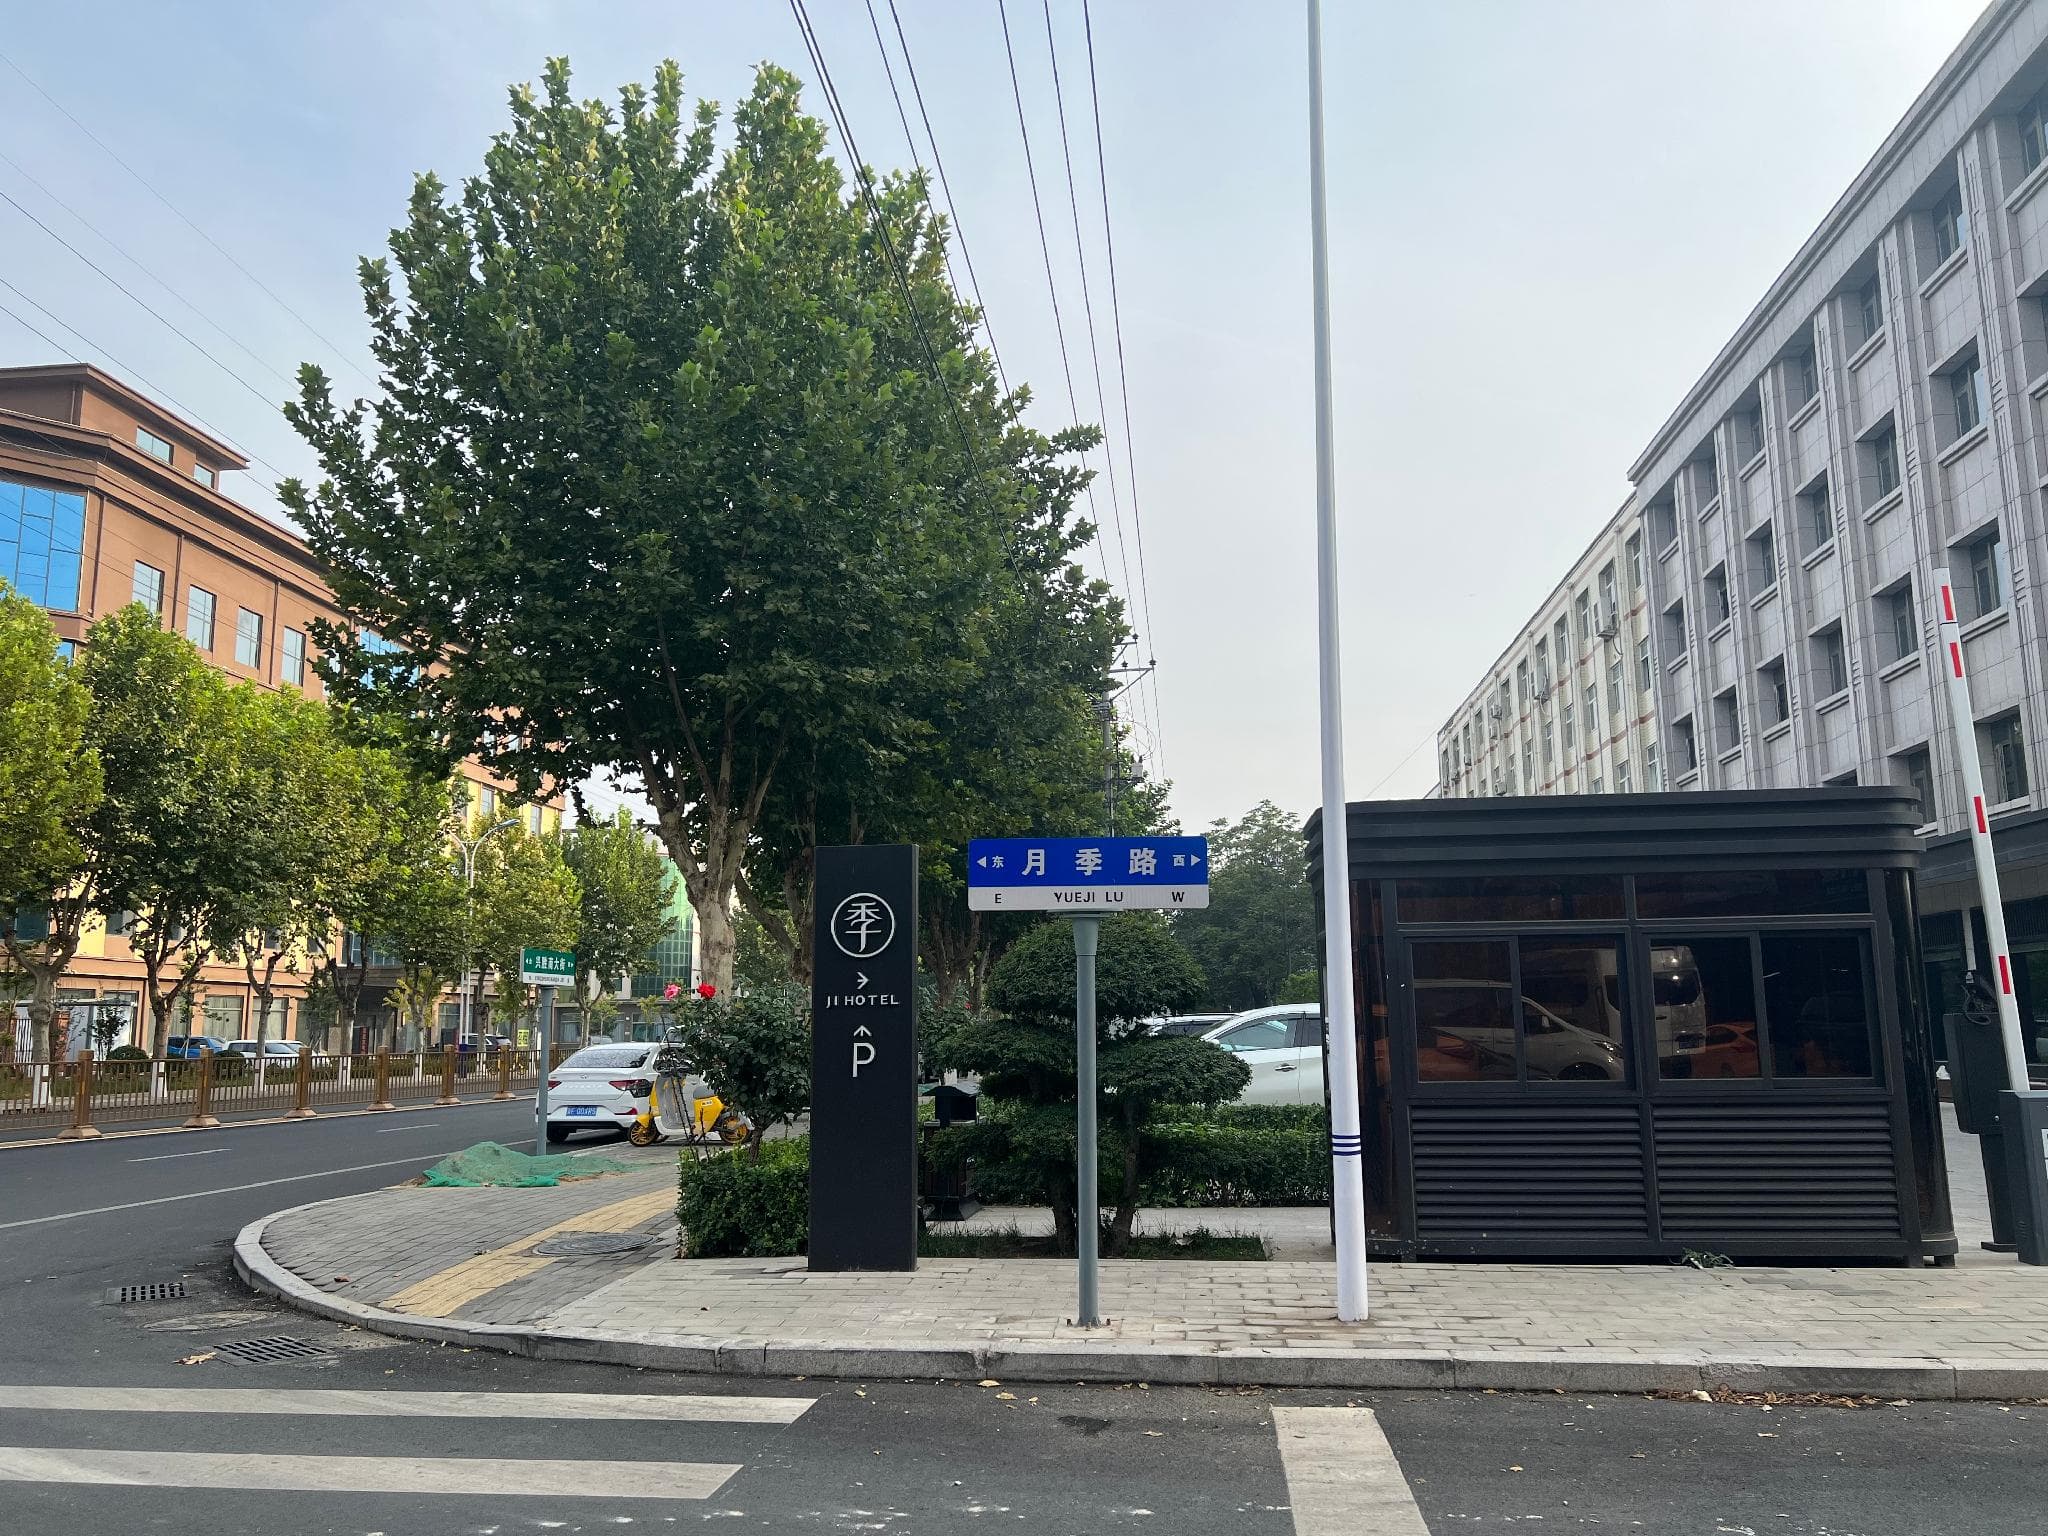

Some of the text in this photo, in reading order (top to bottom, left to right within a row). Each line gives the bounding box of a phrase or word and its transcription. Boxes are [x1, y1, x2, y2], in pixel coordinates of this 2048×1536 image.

[991, 848, 1186, 876] 东 月季路 西
[994, 891, 1185, 904] E YUEJI LU W
[843, 901, 883, 953] 季
[826, 994, 900, 1009] JI HOTEL
[852, 1042, 876, 1078] P
